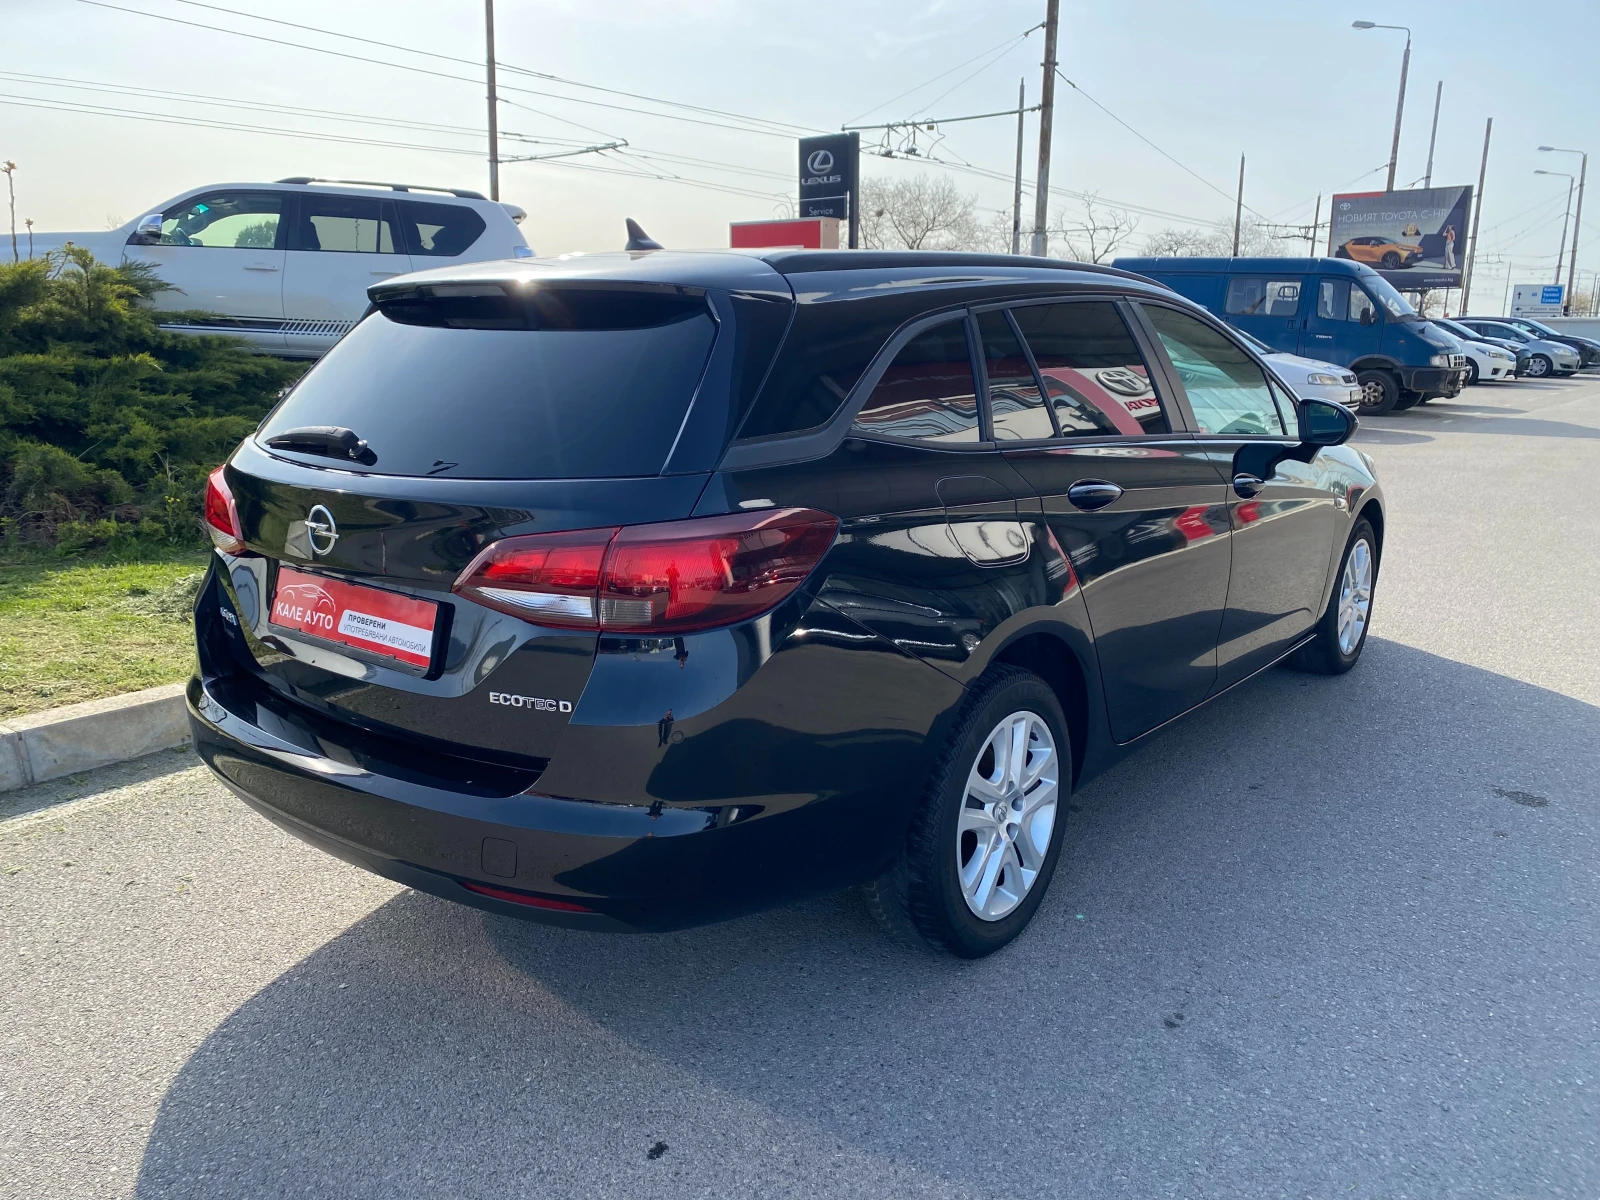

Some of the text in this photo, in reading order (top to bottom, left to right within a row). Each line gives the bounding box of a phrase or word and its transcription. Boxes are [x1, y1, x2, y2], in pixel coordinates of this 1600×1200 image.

[801, 175, 841, 185] LEXUS
[809, 206, 833, 216] Service
[1338, 212, 1378, 222] НОВИЯТ
[276, 602, 334, 630] КАЛЕ АУТО
[348, 613, 387, 630] ПРОВЕРЕНИ
[343, 623, 426, 652] УПОТРЕБЯВАНИ АВТОМОБИЛИ
[489, 691, 556, 712] ECOTEC
